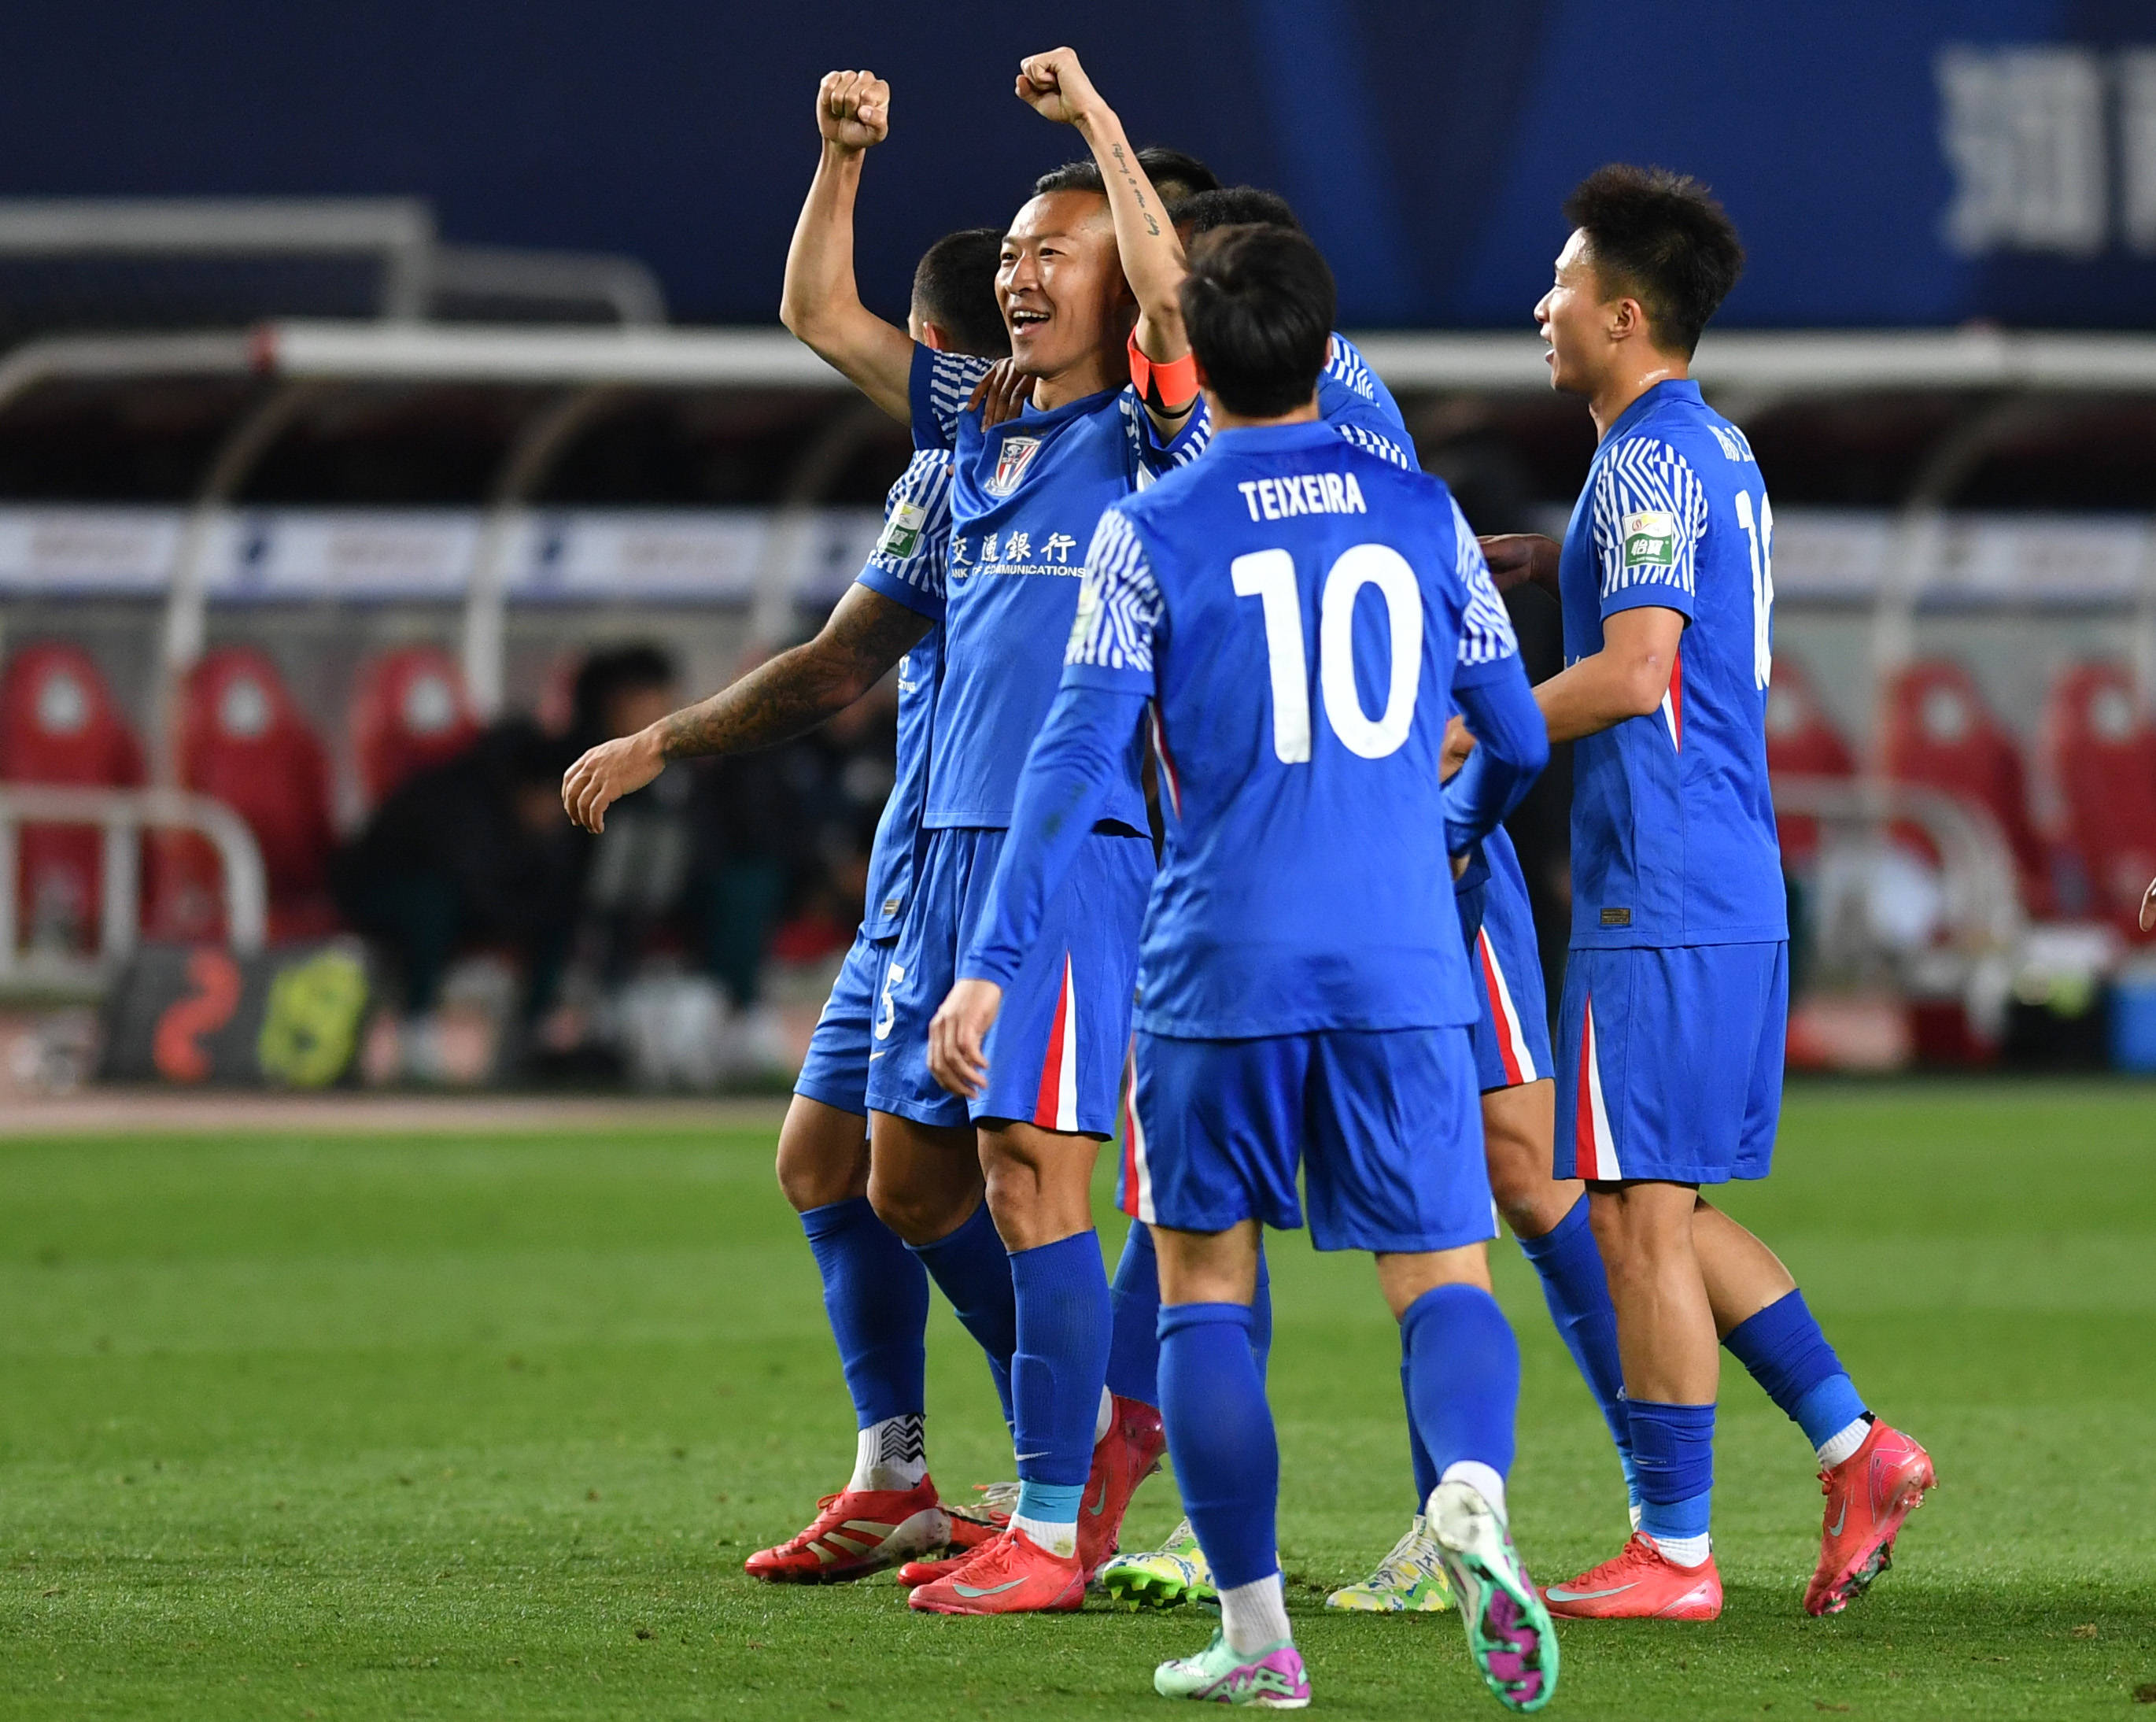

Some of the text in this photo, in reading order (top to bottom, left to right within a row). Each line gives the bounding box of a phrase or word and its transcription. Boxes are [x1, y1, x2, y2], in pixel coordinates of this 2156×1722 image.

[1238, 472, 1368, 523] TEIXEIRA
[951, 530, 1077, 566] 交通銀行
[984, 564, 1087, 578] COMMUNICATIONS
[1231, 543, 1424, 764] 10
